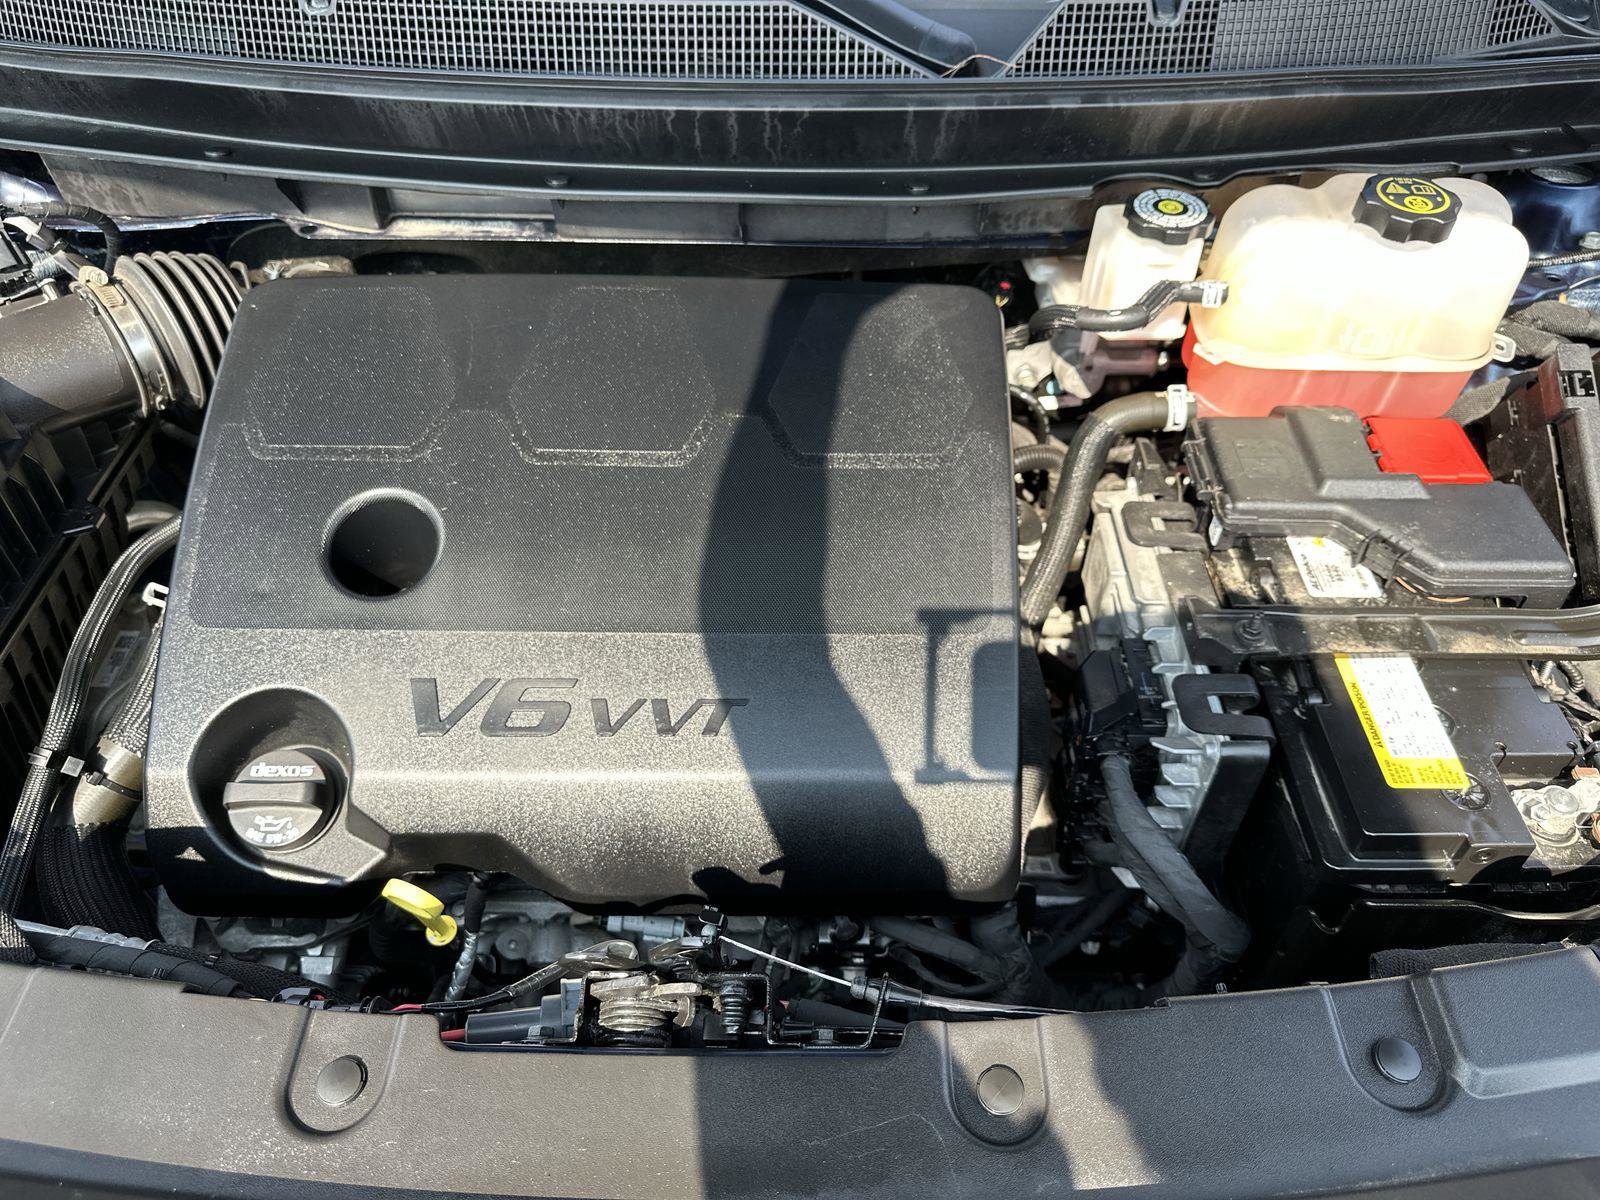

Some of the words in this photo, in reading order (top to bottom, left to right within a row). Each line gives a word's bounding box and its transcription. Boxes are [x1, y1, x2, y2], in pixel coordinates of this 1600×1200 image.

[410, 677, 579, 737] V6
[590, 698, 748, 737] VVT
[249, 761, 316, 778] dexos
